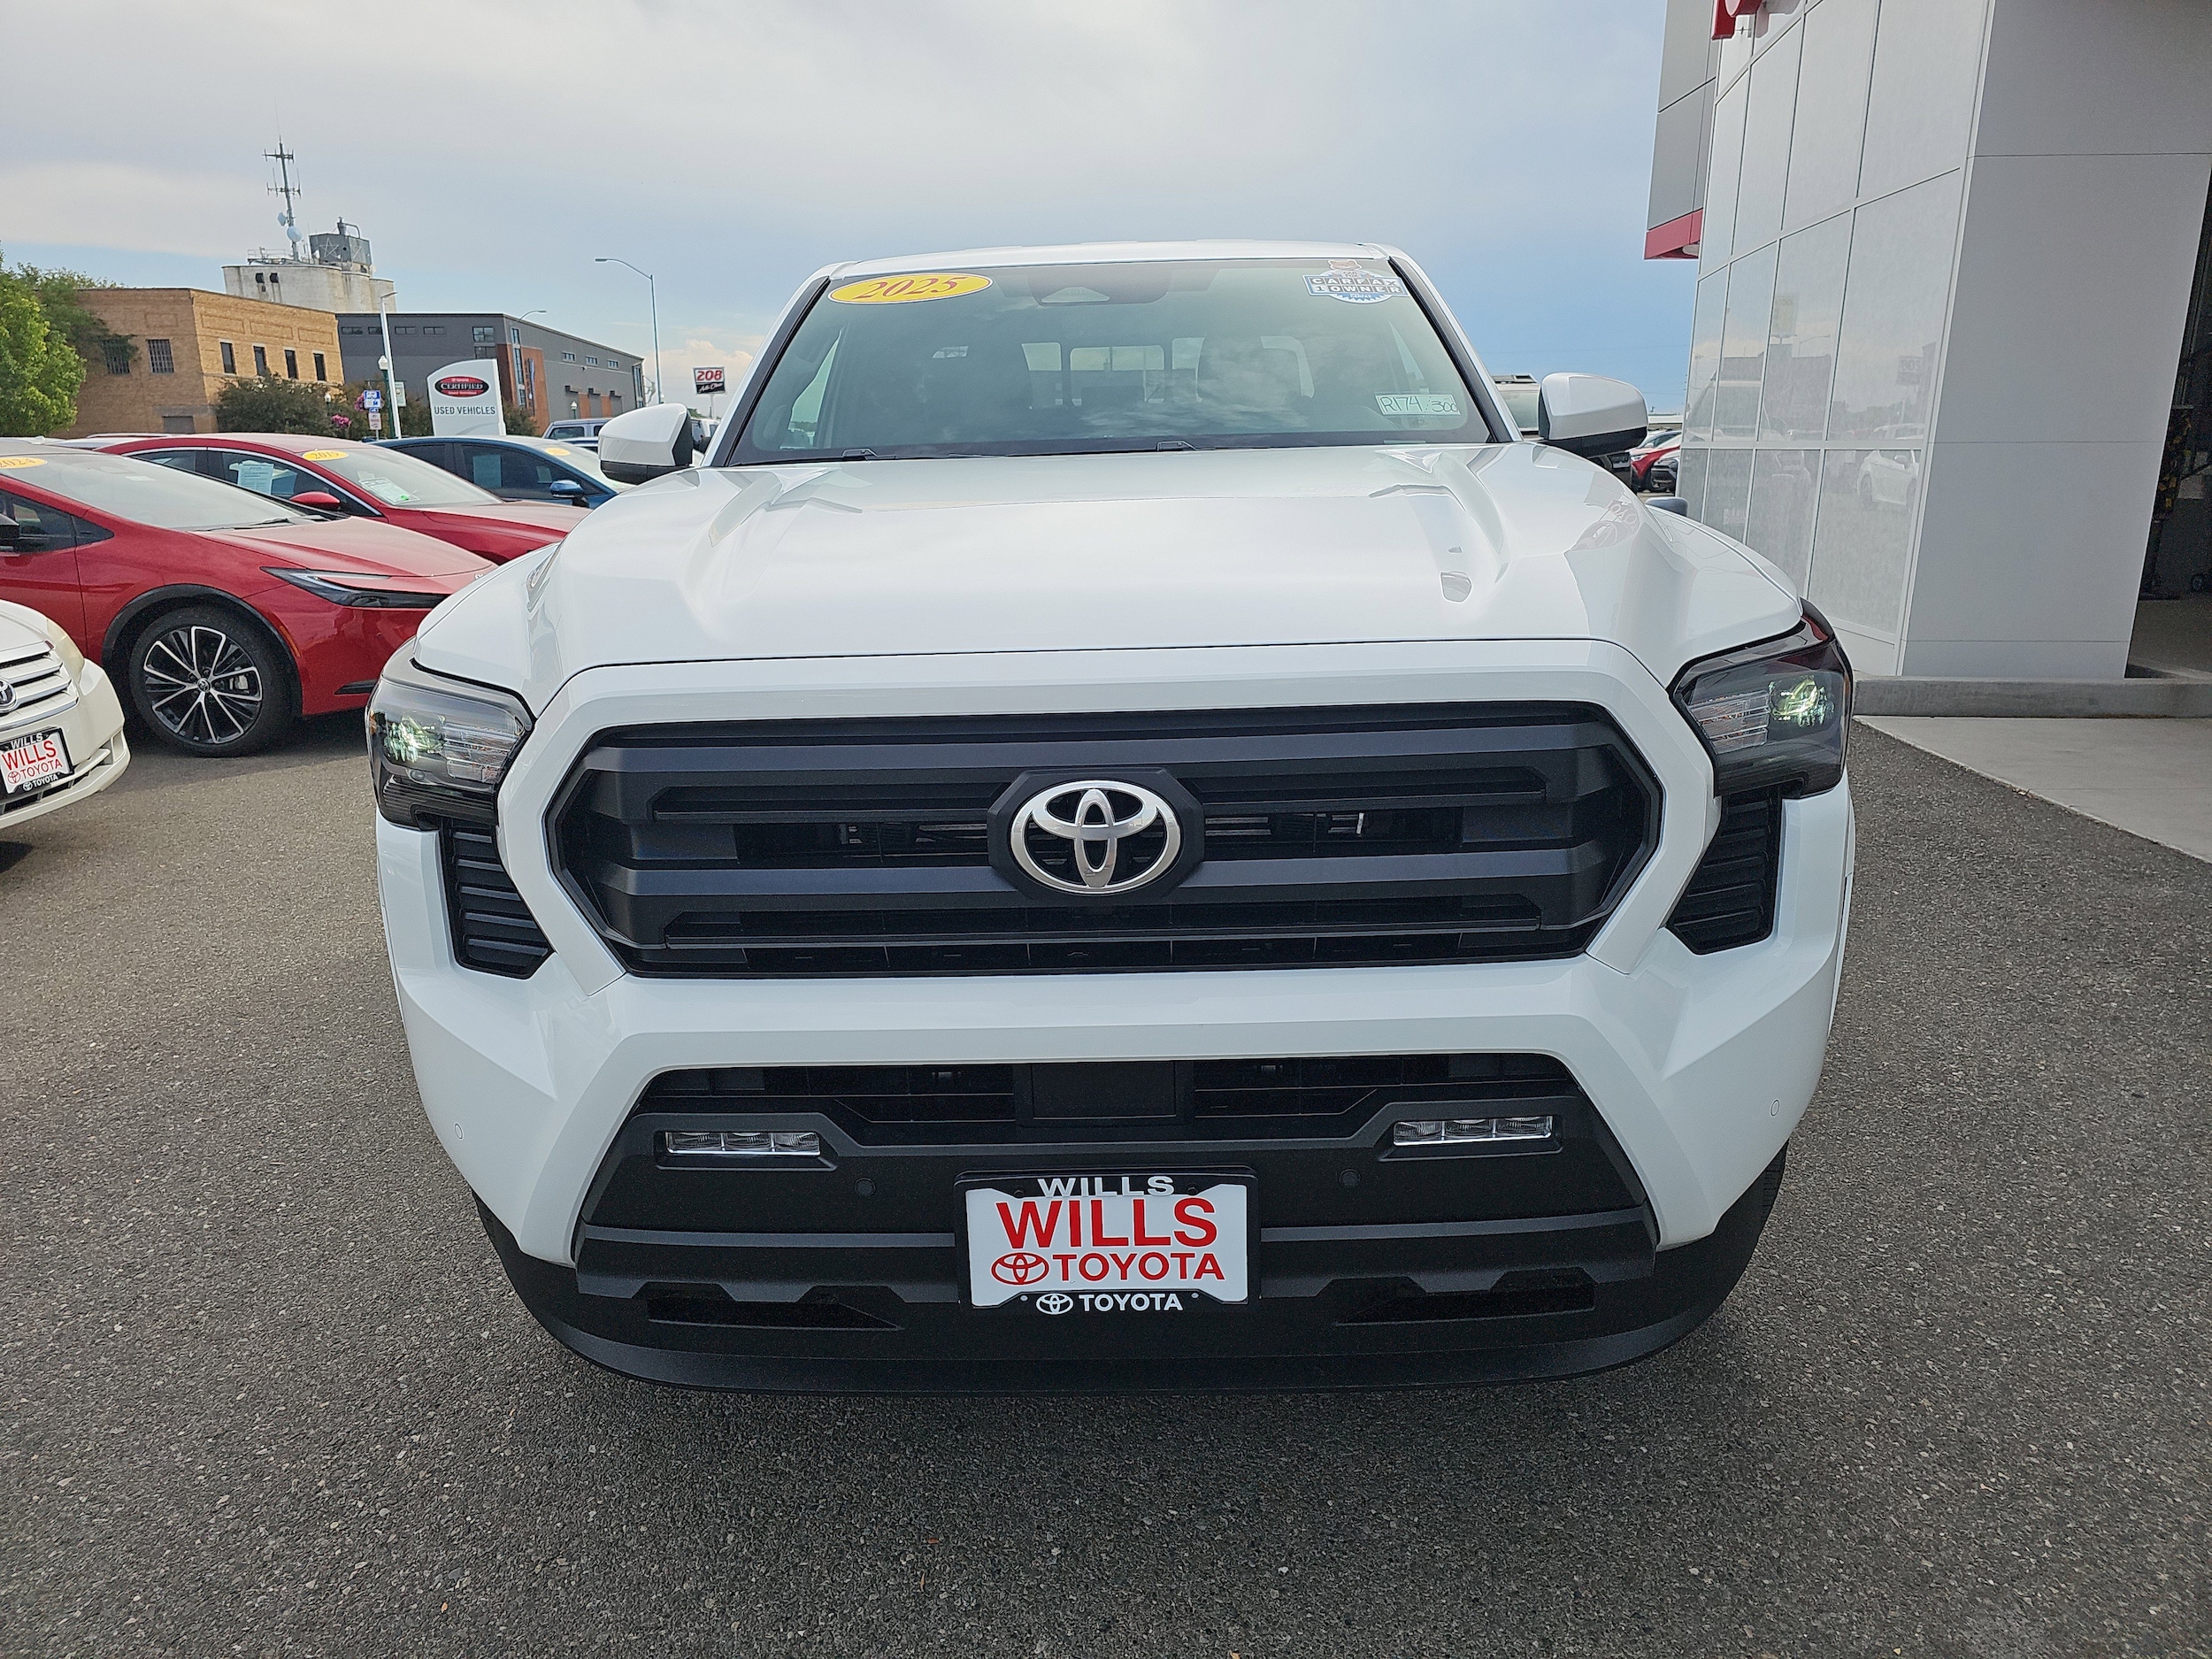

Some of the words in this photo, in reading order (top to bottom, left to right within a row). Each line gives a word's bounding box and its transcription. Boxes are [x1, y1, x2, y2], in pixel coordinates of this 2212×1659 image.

[851, 276, 968, 300] 2025
[696, 370, 722, 381] 208
[434, 406, 455, 415] USED
[457, 406, 495, 415] VEHICLES
[1379, 396, 1423, 412] R174
[11, 732, 43, 749] WILLS
[1, 740, 57, 771] WILLS
[19, 758, 63, 780] TOYOTA
[32, 773, 59, 787] TOYOTA
[1037, 1176, 1175, 1197] WILLS
[995, 1197, 1217, 1248] WILLS
[1052, 1252, 1225, 1282] TOYOTA
[1078, 1293, 1184, 1312] TOYOTA
